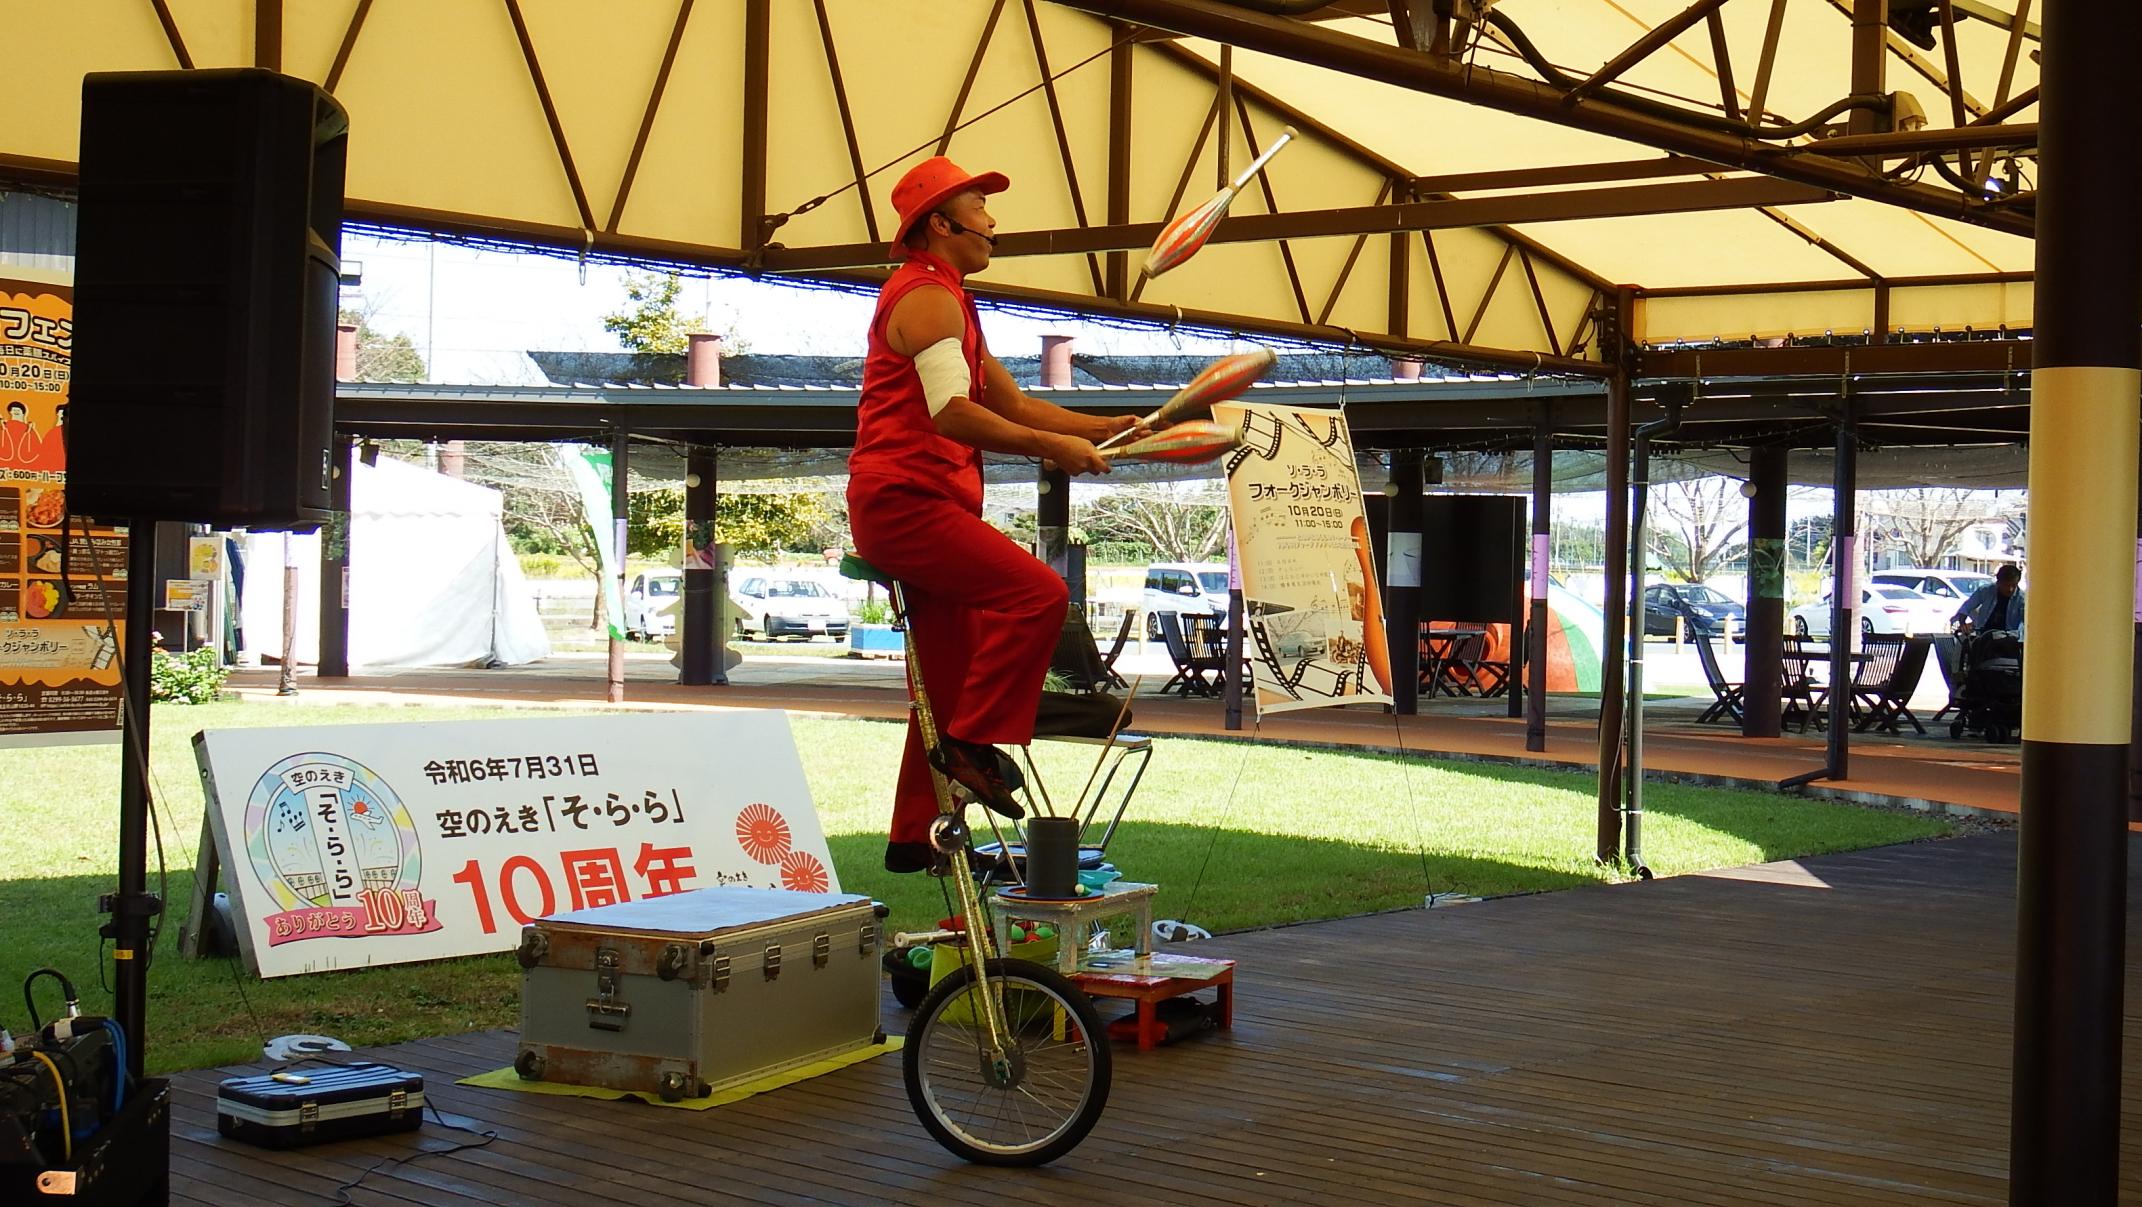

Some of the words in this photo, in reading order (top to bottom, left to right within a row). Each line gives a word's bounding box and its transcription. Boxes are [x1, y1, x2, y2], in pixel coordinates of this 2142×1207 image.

[1249, 482, 1357, 501] フォークジャンボリー
[0, 641, 68, 654] クジャンボリー
[291, 769, 345, 787] 空のえき
[423, 753, 599, 785] 令和6年7月31日
[436, 788, 684, 838] 空のえき「そ・ら・ら」
[452, 842, 697, 934] 10周年
[274, 912, 357, 936] ありがとう
